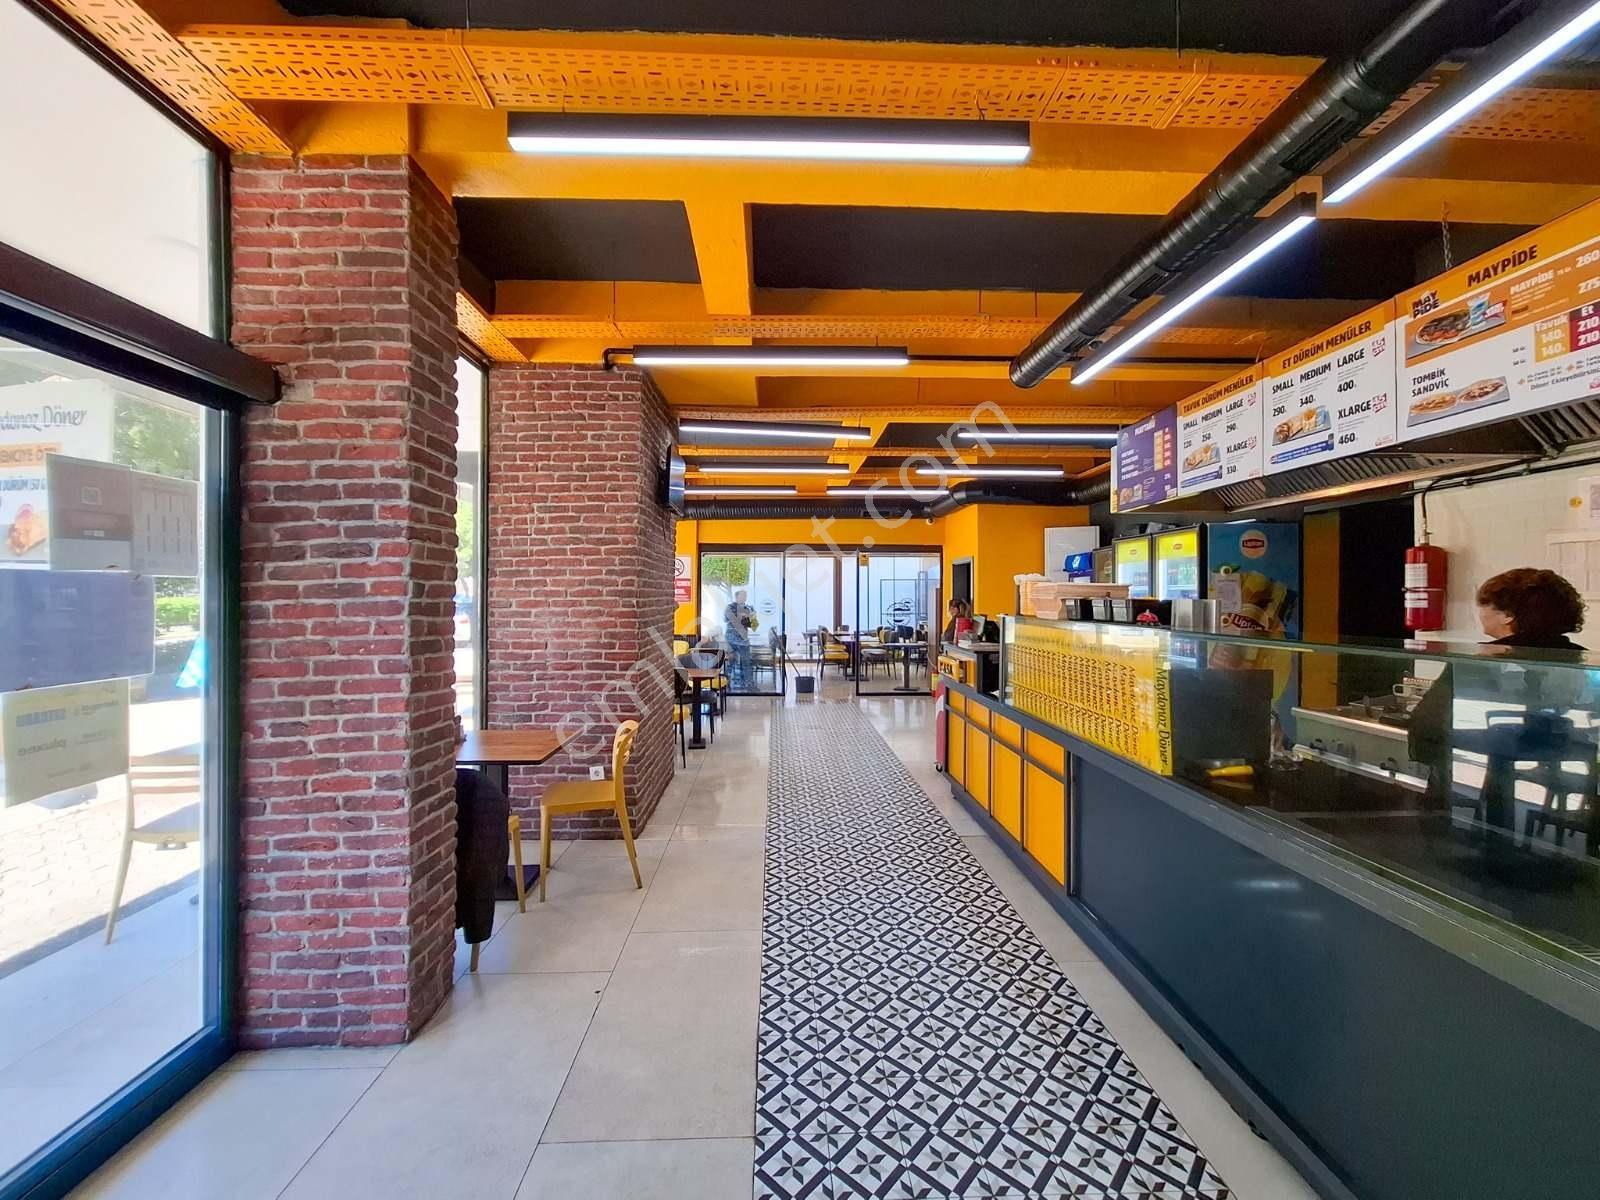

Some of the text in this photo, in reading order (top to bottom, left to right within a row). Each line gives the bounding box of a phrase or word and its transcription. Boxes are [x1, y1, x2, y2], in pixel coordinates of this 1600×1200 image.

[1282, 358, 1292, 370] ET
[1294, 342, 1324, 366] DÜRÜM
[1326, 320, 1372, 350] MENÜLER
[1272, 378, 1295, 395] SMALL
[1299, 361, 1332, 384] MEDIUM
[1337, 347, 1366, 368] LARGE
[43, 405, 88, 428] Döner
[1225, 398, 1244, 413] LARGE
[1337, 397, 1372, 420] XLARGE
[1154, 667, 1171, 766] Maydonoz Döner
